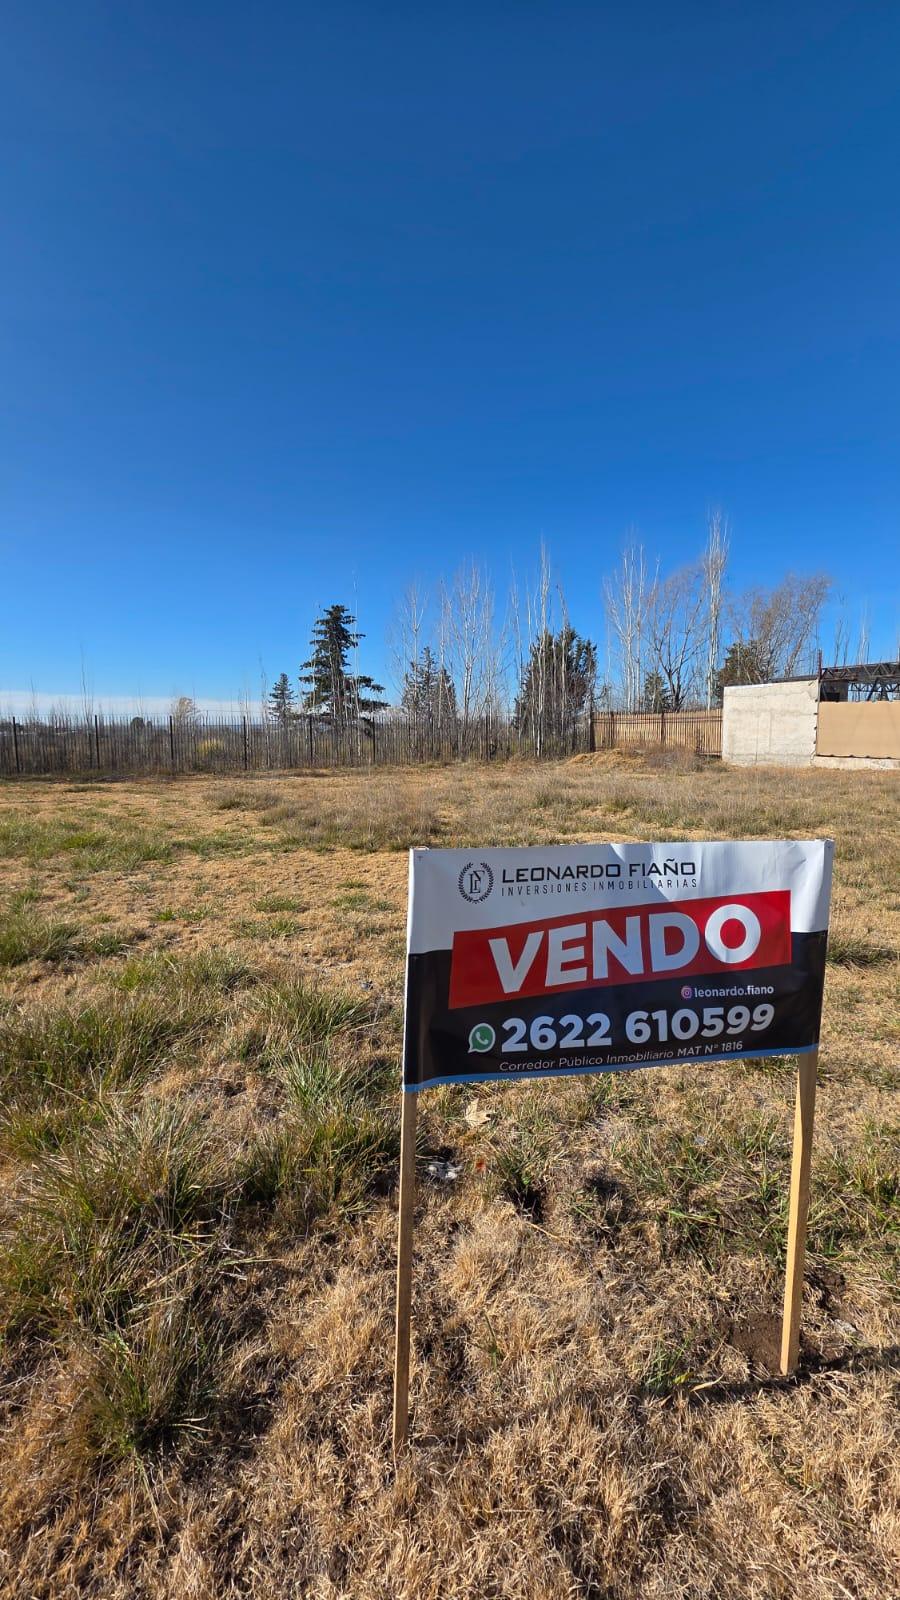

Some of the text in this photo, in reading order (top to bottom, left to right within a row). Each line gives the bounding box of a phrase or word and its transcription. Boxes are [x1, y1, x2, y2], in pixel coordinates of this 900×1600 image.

[502, 858, 696, 883] LEONARDO FIAÑO
[501, 878, 697, 896] INVERSIONES INMOBILIARIAS
[489, 903, 761, 993] VENDO
[694, 985, 774, 998] leonardo.fiano
[502, 1003, 775, 1053] 2622 610599
[499, 1059, 555, 1072] Corredor
[559, 1055, 603, 1068] Público
[606, 1050, 674, 1064] Inmobiliario
[677, 1046, 702, 1057] MAT
[721, 1040, 744, 1052] 1816
